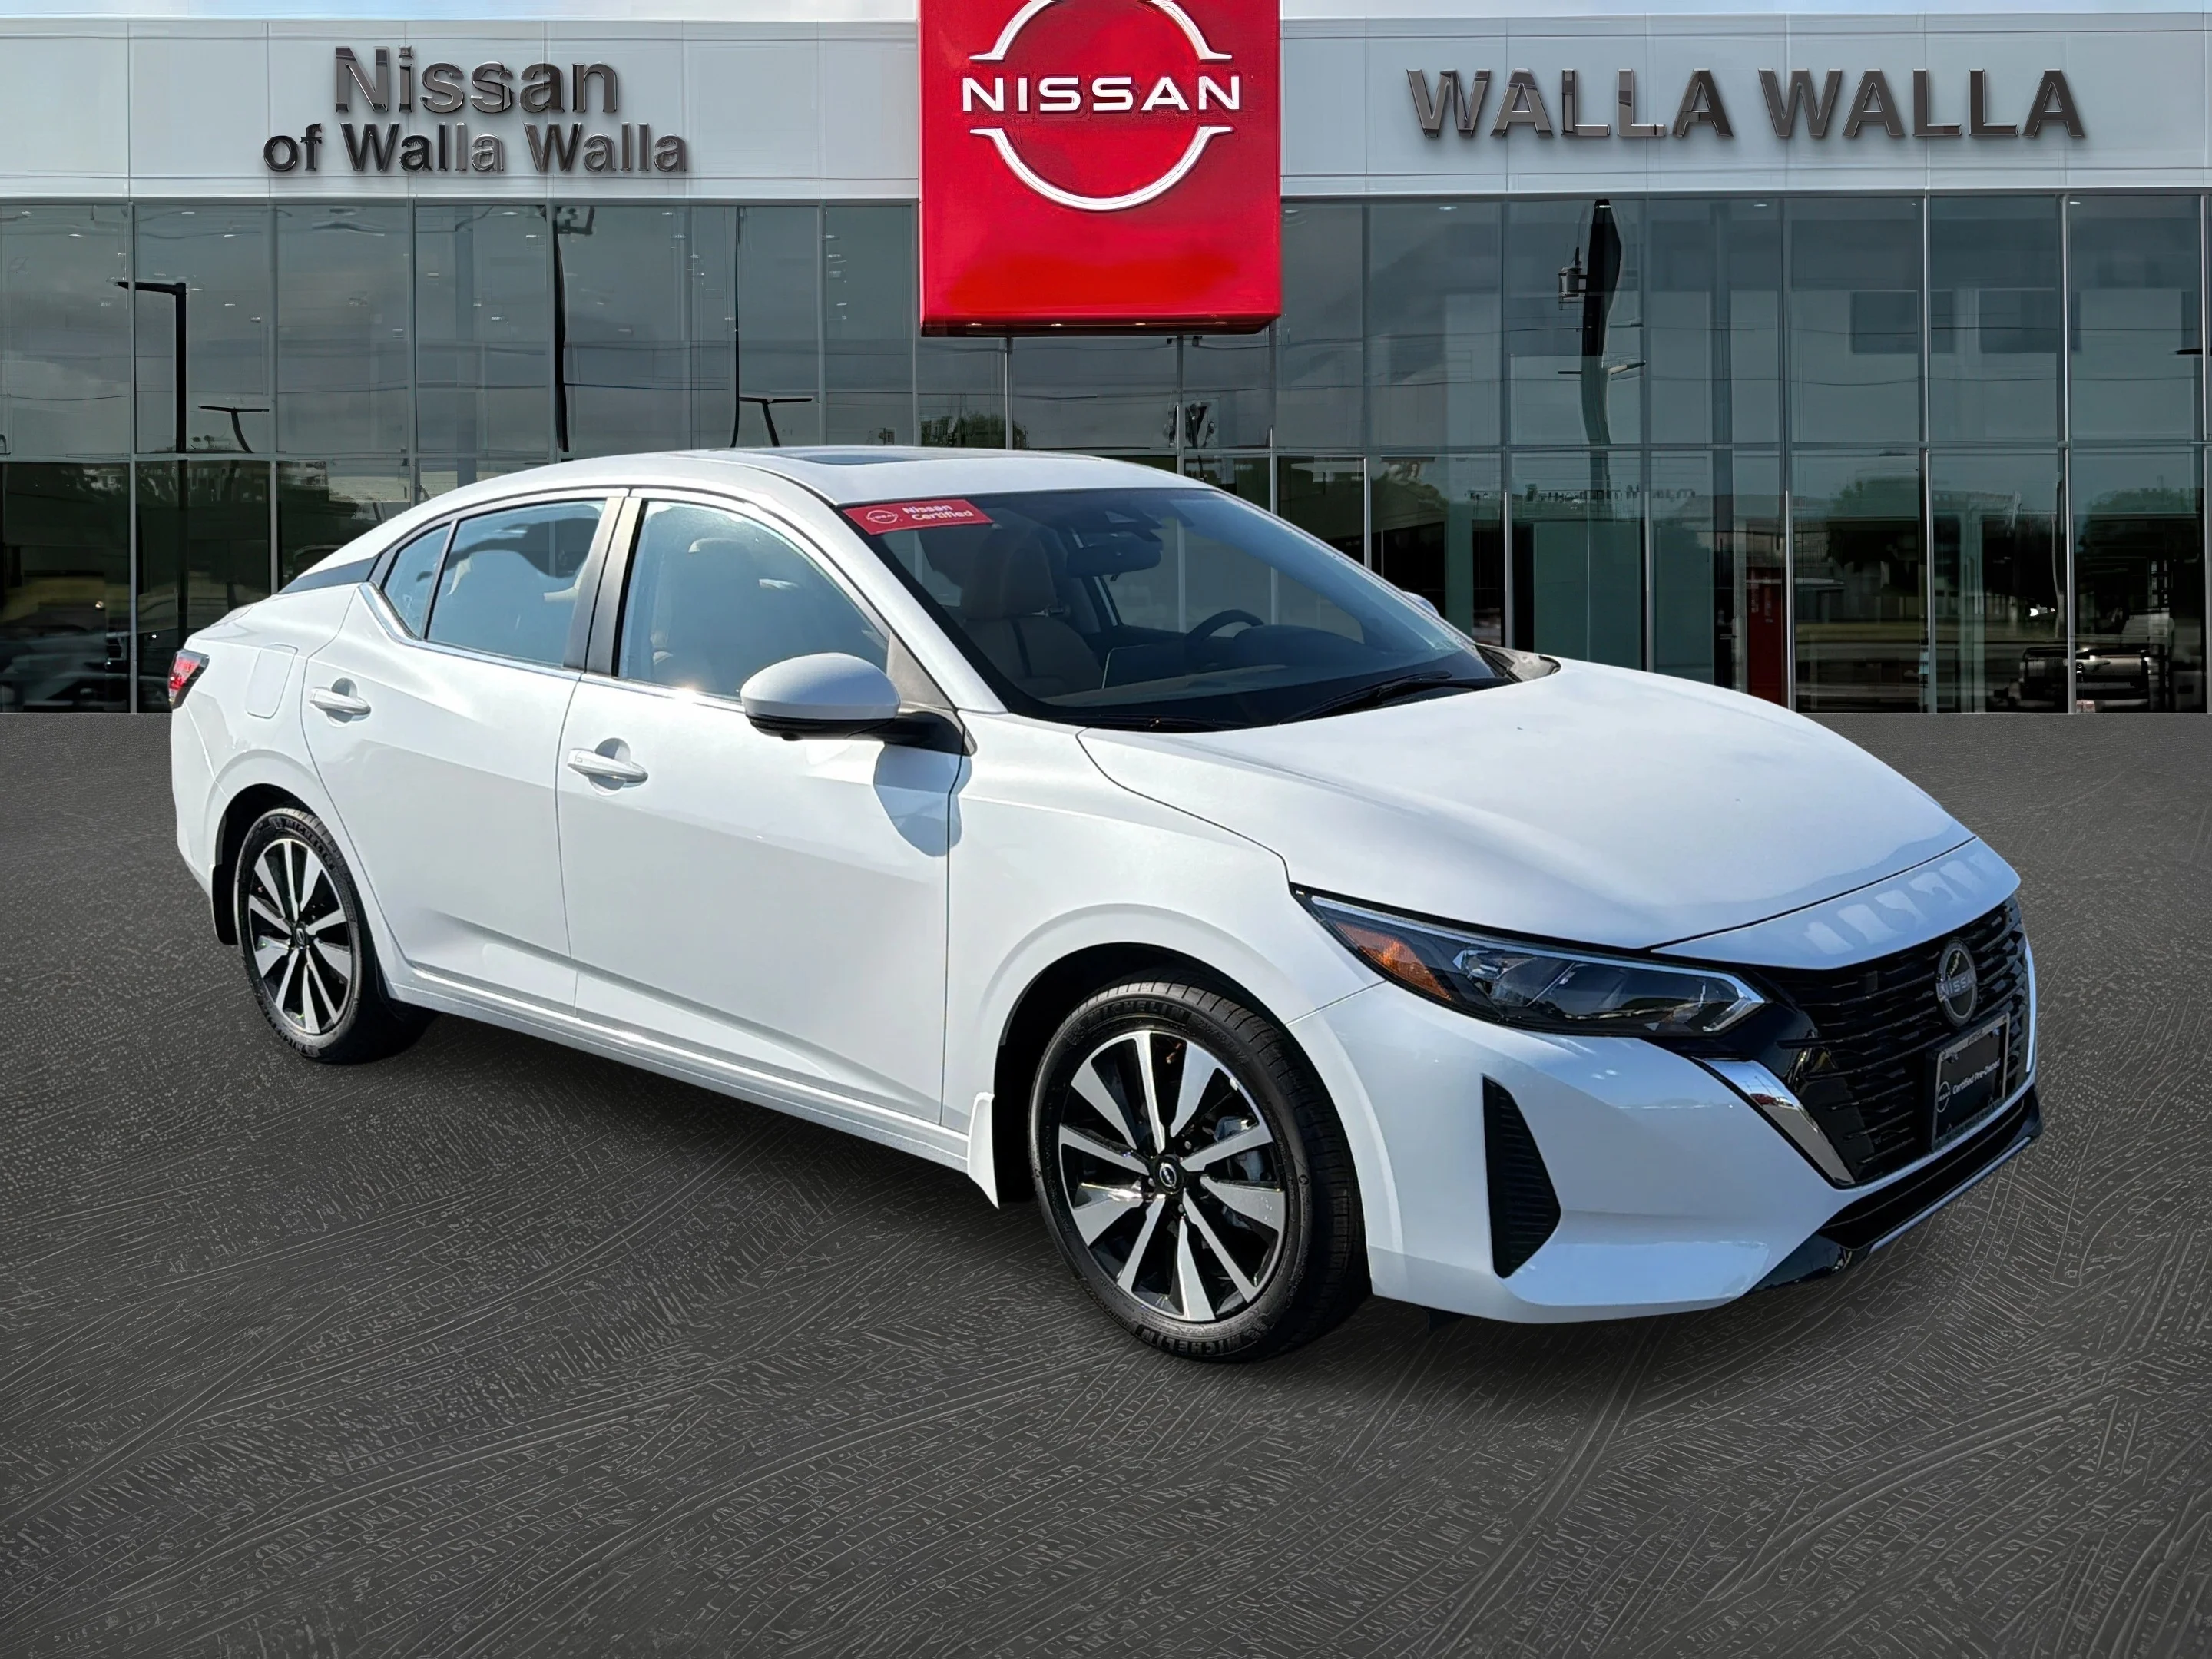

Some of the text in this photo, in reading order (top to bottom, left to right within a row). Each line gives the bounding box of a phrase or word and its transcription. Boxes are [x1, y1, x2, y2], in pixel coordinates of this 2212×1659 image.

[335, 45, 617, 112] Nissan
[962, 75, 1240, 111] NISSAN
[1406, 68, 2085, 138] WALLA WALLA
[263, 122, 687, 172] of Walla Walla
[902, 505, 953, 515] Nissan
[911, 510, 975, 522] Certified
[1936, 969, 1975, 998] NISSA
[1087, 1001, 1190, 1022] MICHELIN
[1139, 1331, 1244, 1354] MICHELIN
